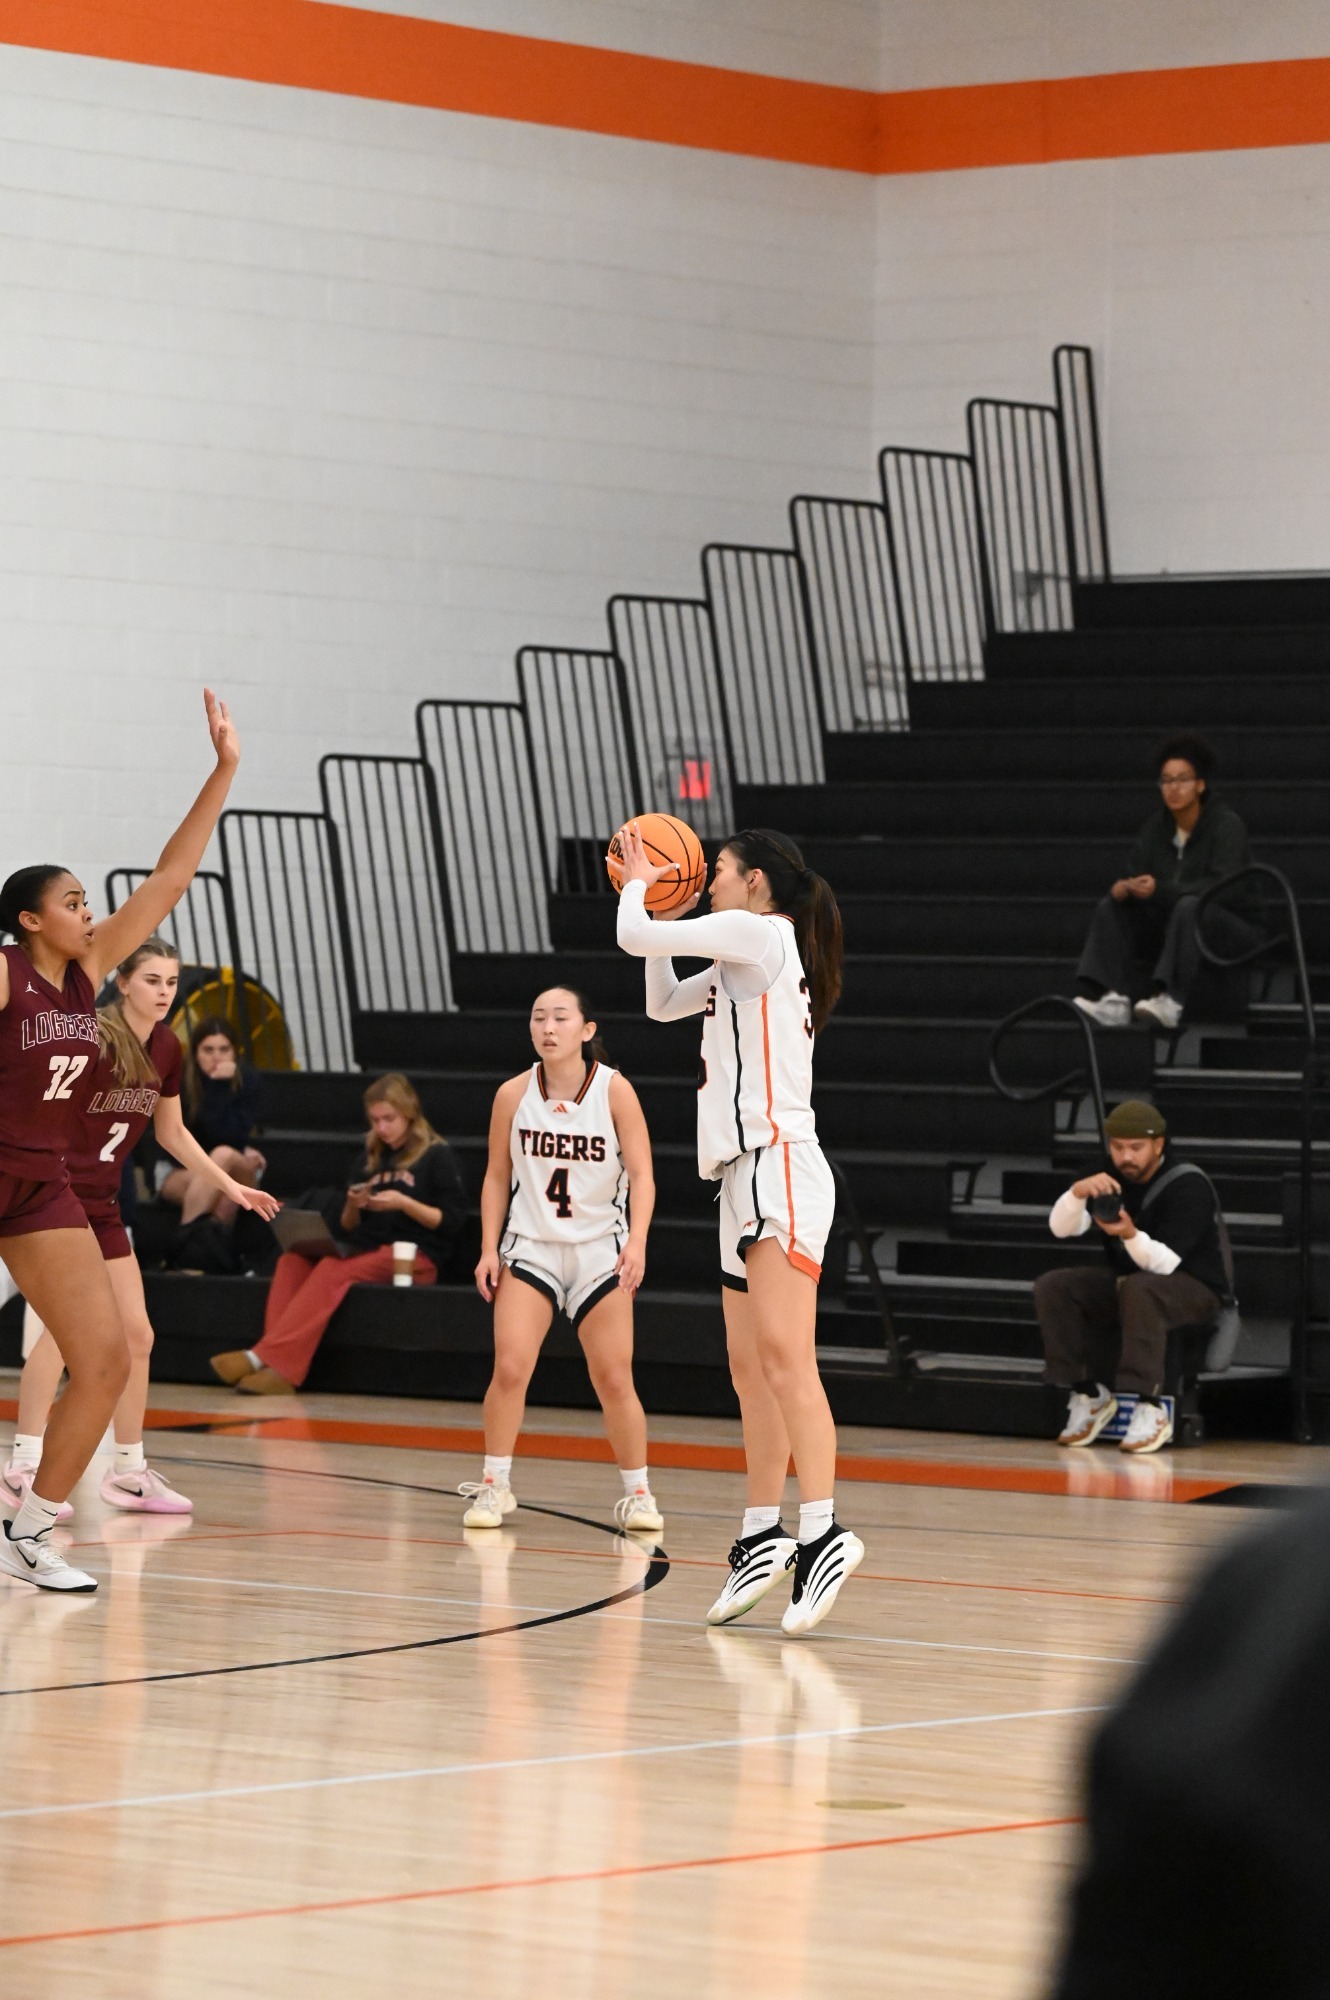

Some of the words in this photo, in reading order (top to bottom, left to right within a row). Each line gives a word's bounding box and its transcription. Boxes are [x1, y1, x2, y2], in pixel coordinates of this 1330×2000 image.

[43, 1055, 89, 1101] 32
[99, 1122, 130, 1163] 2
[519, 1128, 606, 1163] TIGERS
[545, 1168, 573, 1218] 4
